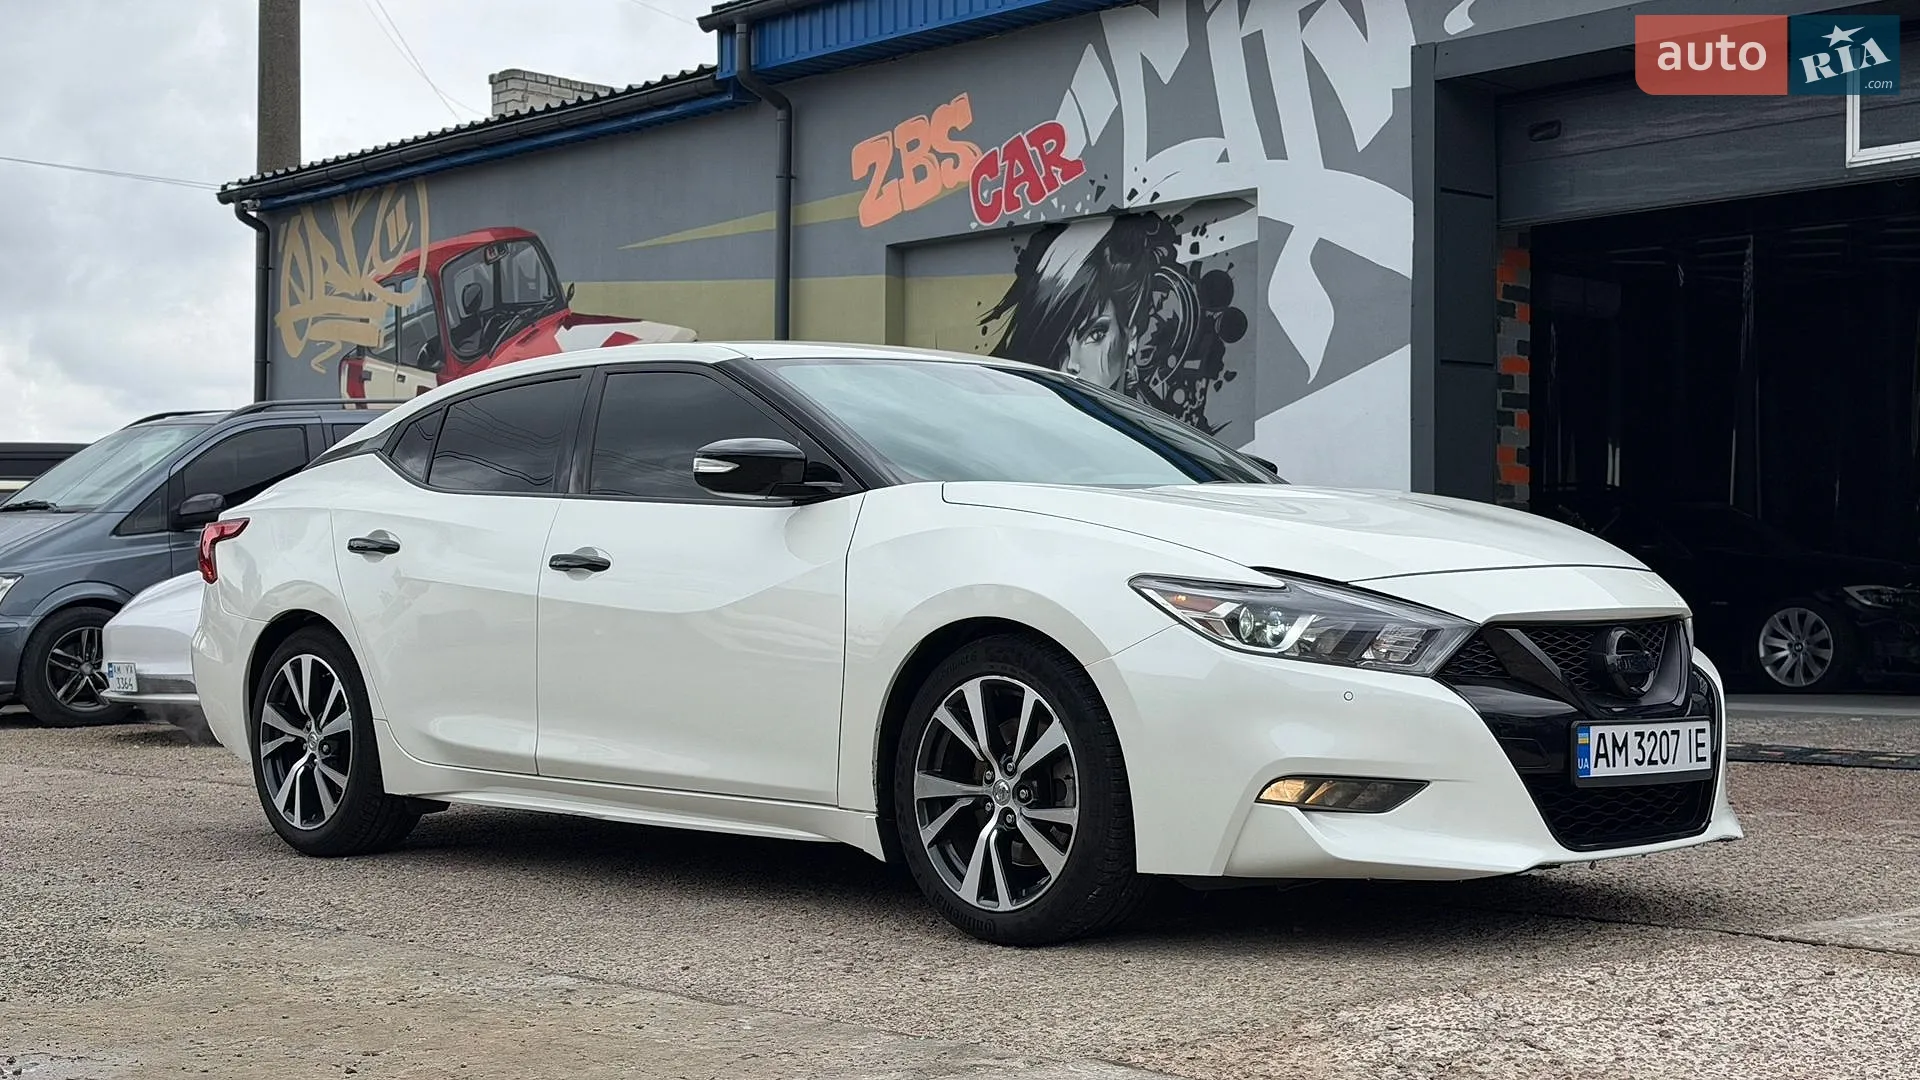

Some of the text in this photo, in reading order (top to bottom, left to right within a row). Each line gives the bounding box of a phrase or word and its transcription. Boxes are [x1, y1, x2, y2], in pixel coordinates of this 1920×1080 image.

[851, 92, 982, 228] ZBS
[969, 120, 1086, 226] CAR
[1577, 758, 1590, 770] UA
[1593, 727, 1707, 768] AM 3207 IE
